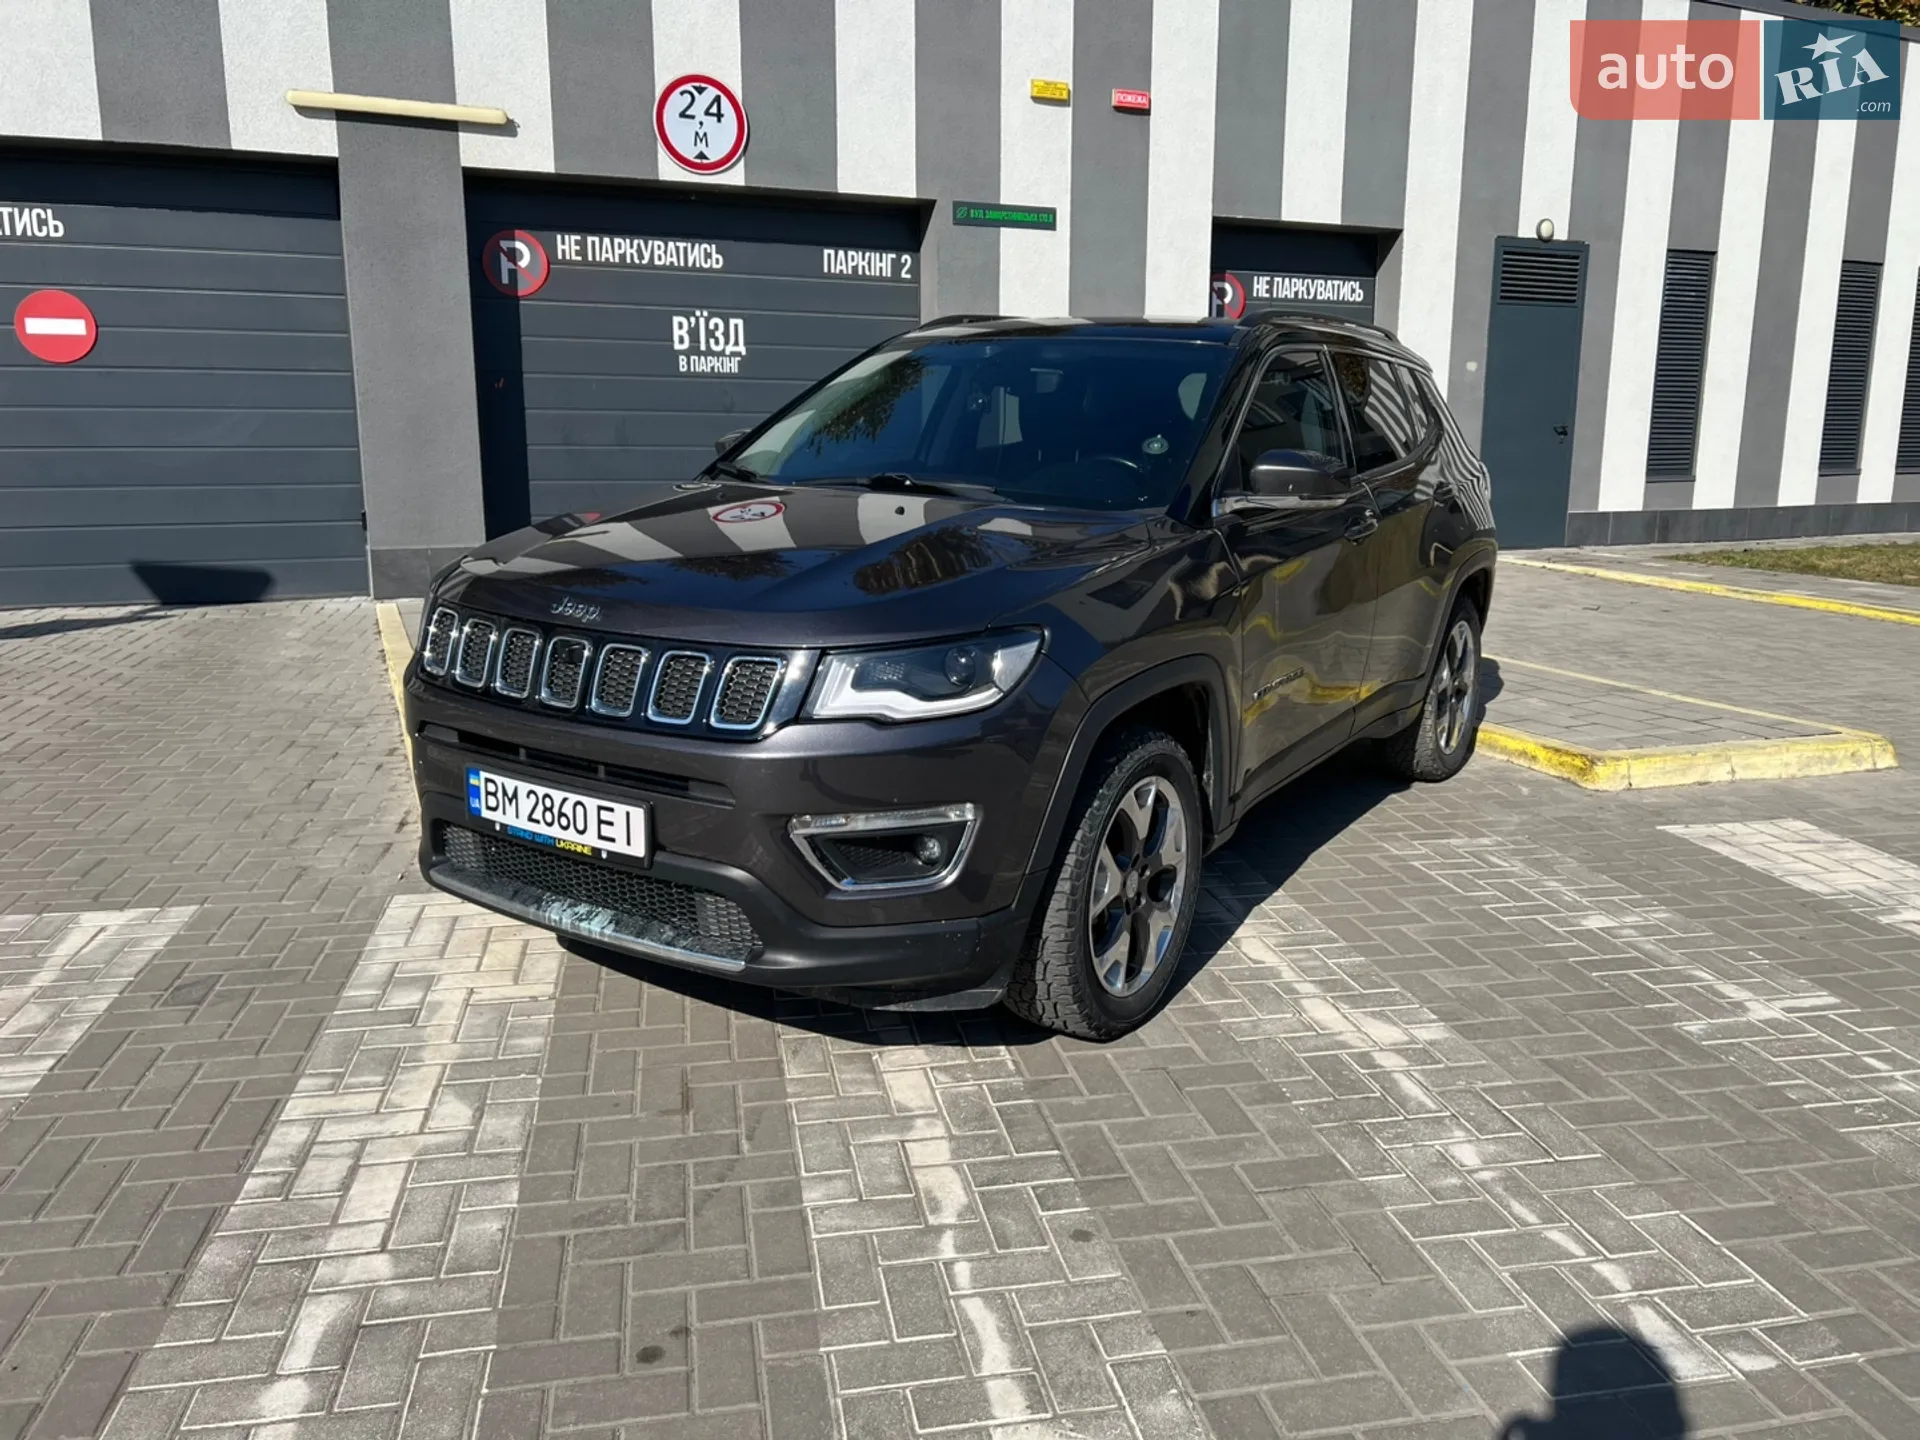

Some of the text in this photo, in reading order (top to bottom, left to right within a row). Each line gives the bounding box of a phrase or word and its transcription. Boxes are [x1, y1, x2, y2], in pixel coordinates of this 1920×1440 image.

[0, 206, 65, 238] ТИСЬ
[556, 234, 724, 269] НЕ ПАРКУВАТИСЬ
[823, 248, 912, 279] ПАРКІНГ 2
[1253, 275, 1364, 302] НЕ ПАРКУВАТИСЬ
[678, 355, 742, 373] В ПАРКІНГ
[550, 596, 601, 623] Jeep
[484, 777, 631, 846] BM 2860 EI
[555, 838, 592, 856] UKRAINE
